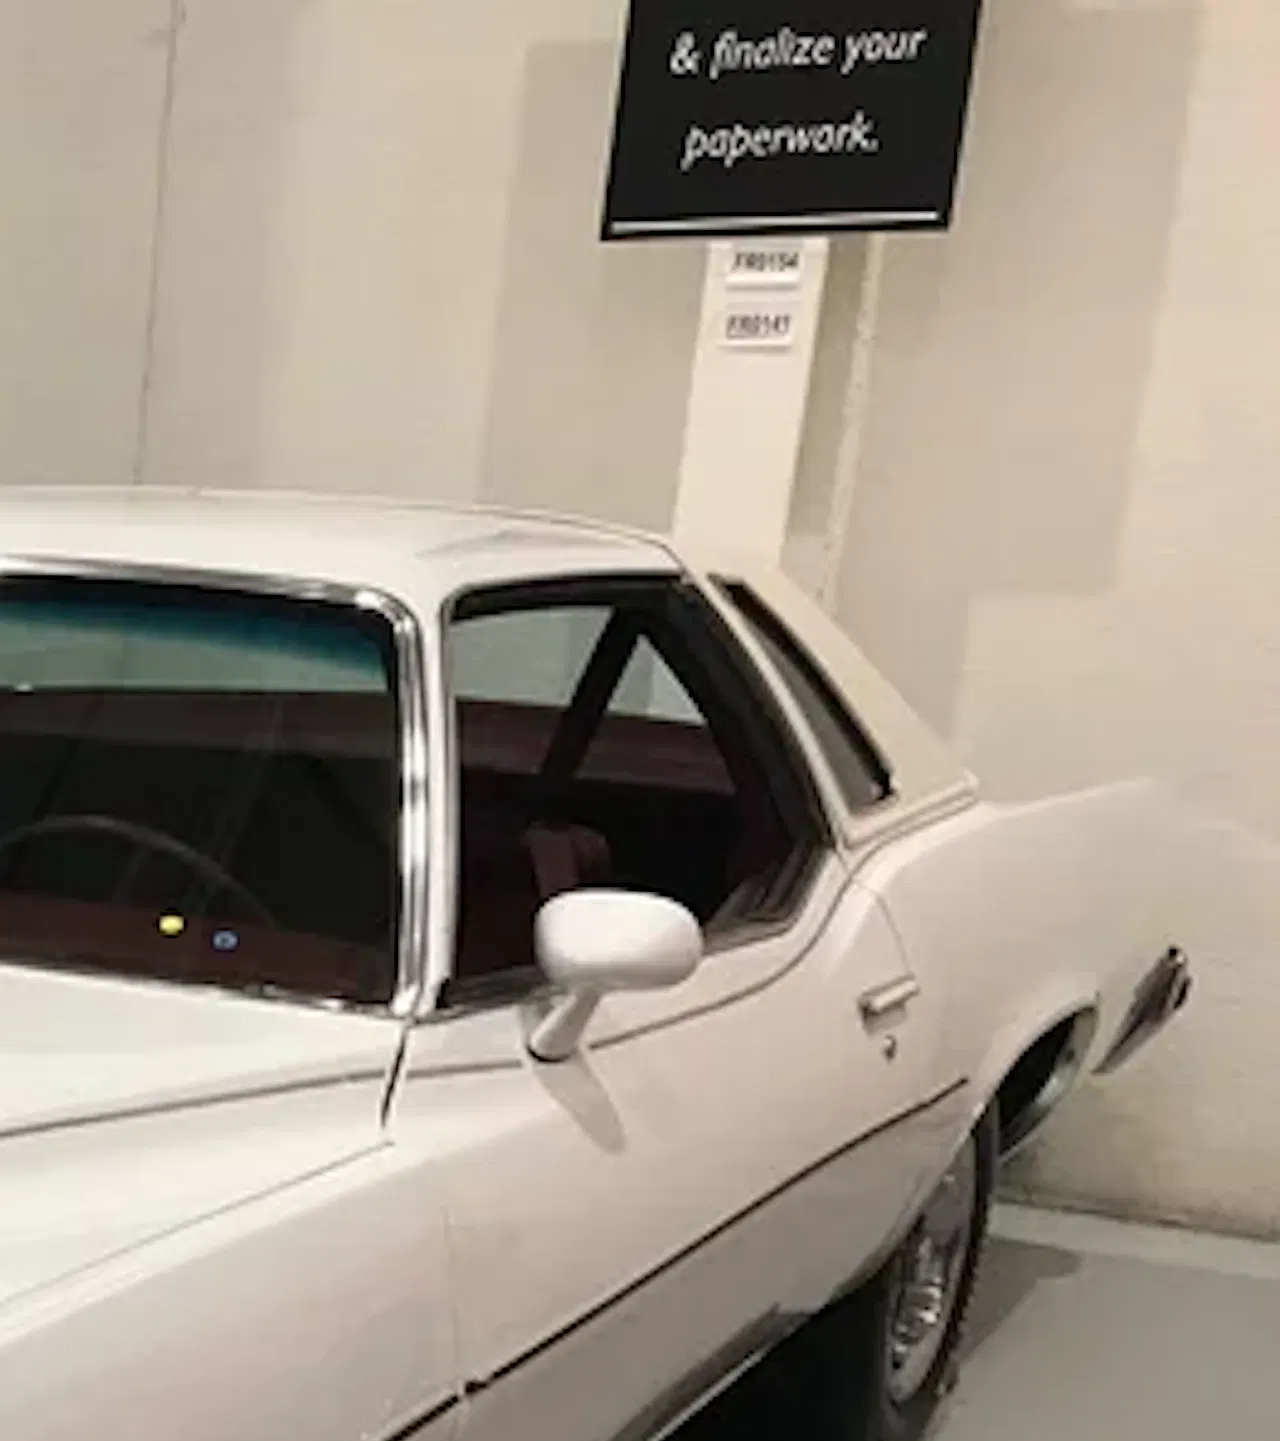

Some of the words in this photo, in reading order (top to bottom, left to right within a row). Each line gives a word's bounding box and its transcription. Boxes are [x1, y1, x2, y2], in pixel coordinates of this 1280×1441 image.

[669, 30, 701, 75] &
[708, 25, 836, 80] finalize
[841, 28, 928, 76] your
[680, 109, 880, 171] paperwork.
